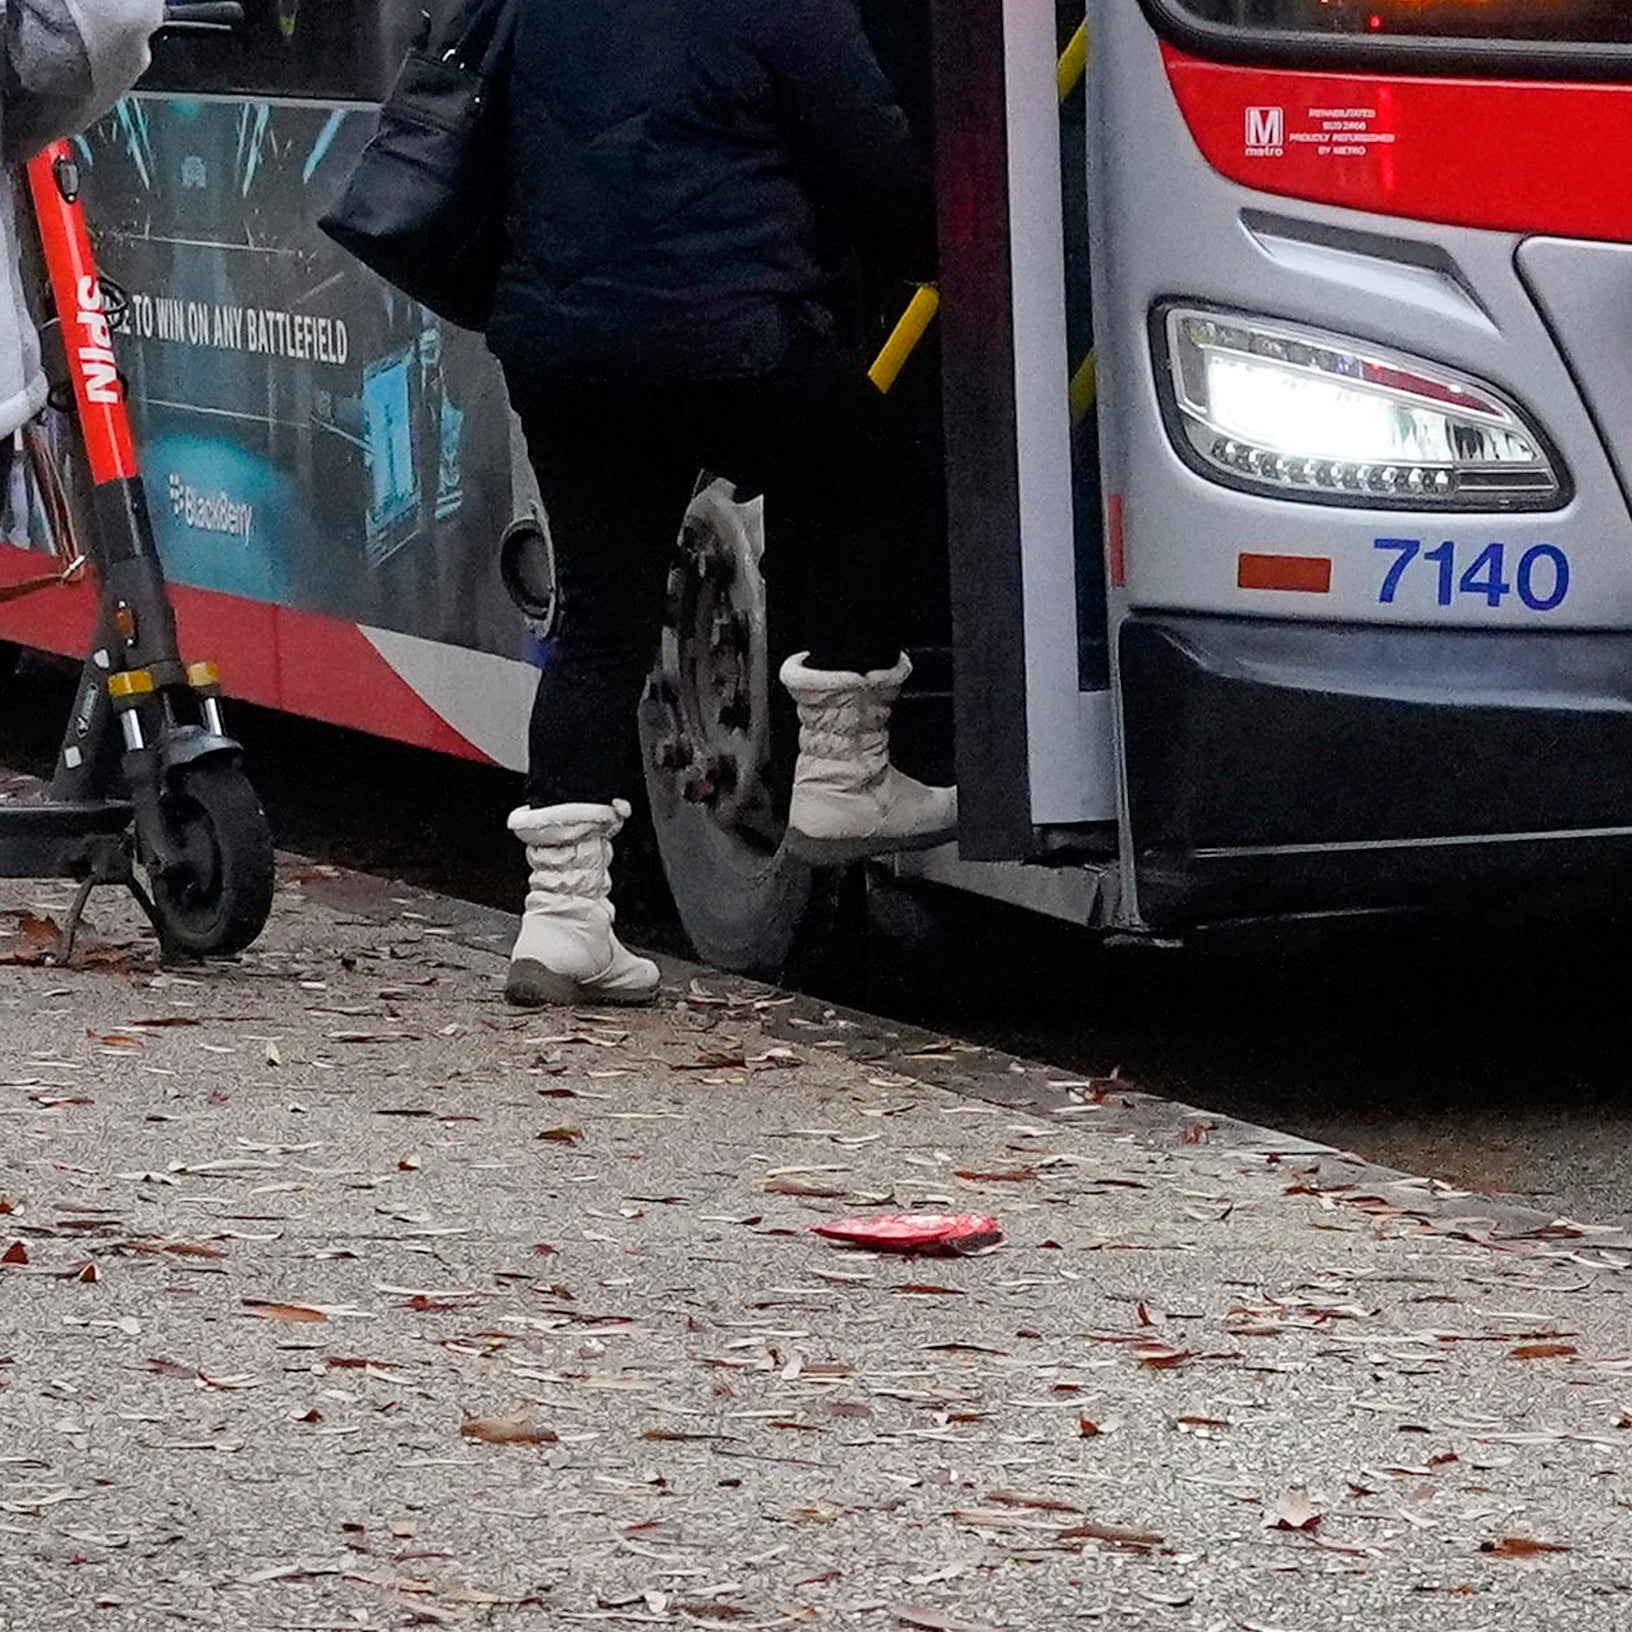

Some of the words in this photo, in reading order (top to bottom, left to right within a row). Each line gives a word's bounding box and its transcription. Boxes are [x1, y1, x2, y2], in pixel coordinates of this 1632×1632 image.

[1244, 147, 1284, 157] metro
[1247, 108, 1281, 146] M
[76, 274, 118, 405] SPIN
[132, 294, 153, 339] TO
[155, 297, 185, 342] WIN
[188, 301, 210, 345] ON
[212, 304, 244, 350] ANY
[246, 308, 349, 365] BATTLEFIELD
[1372, 538, 1571, 611] 7140
